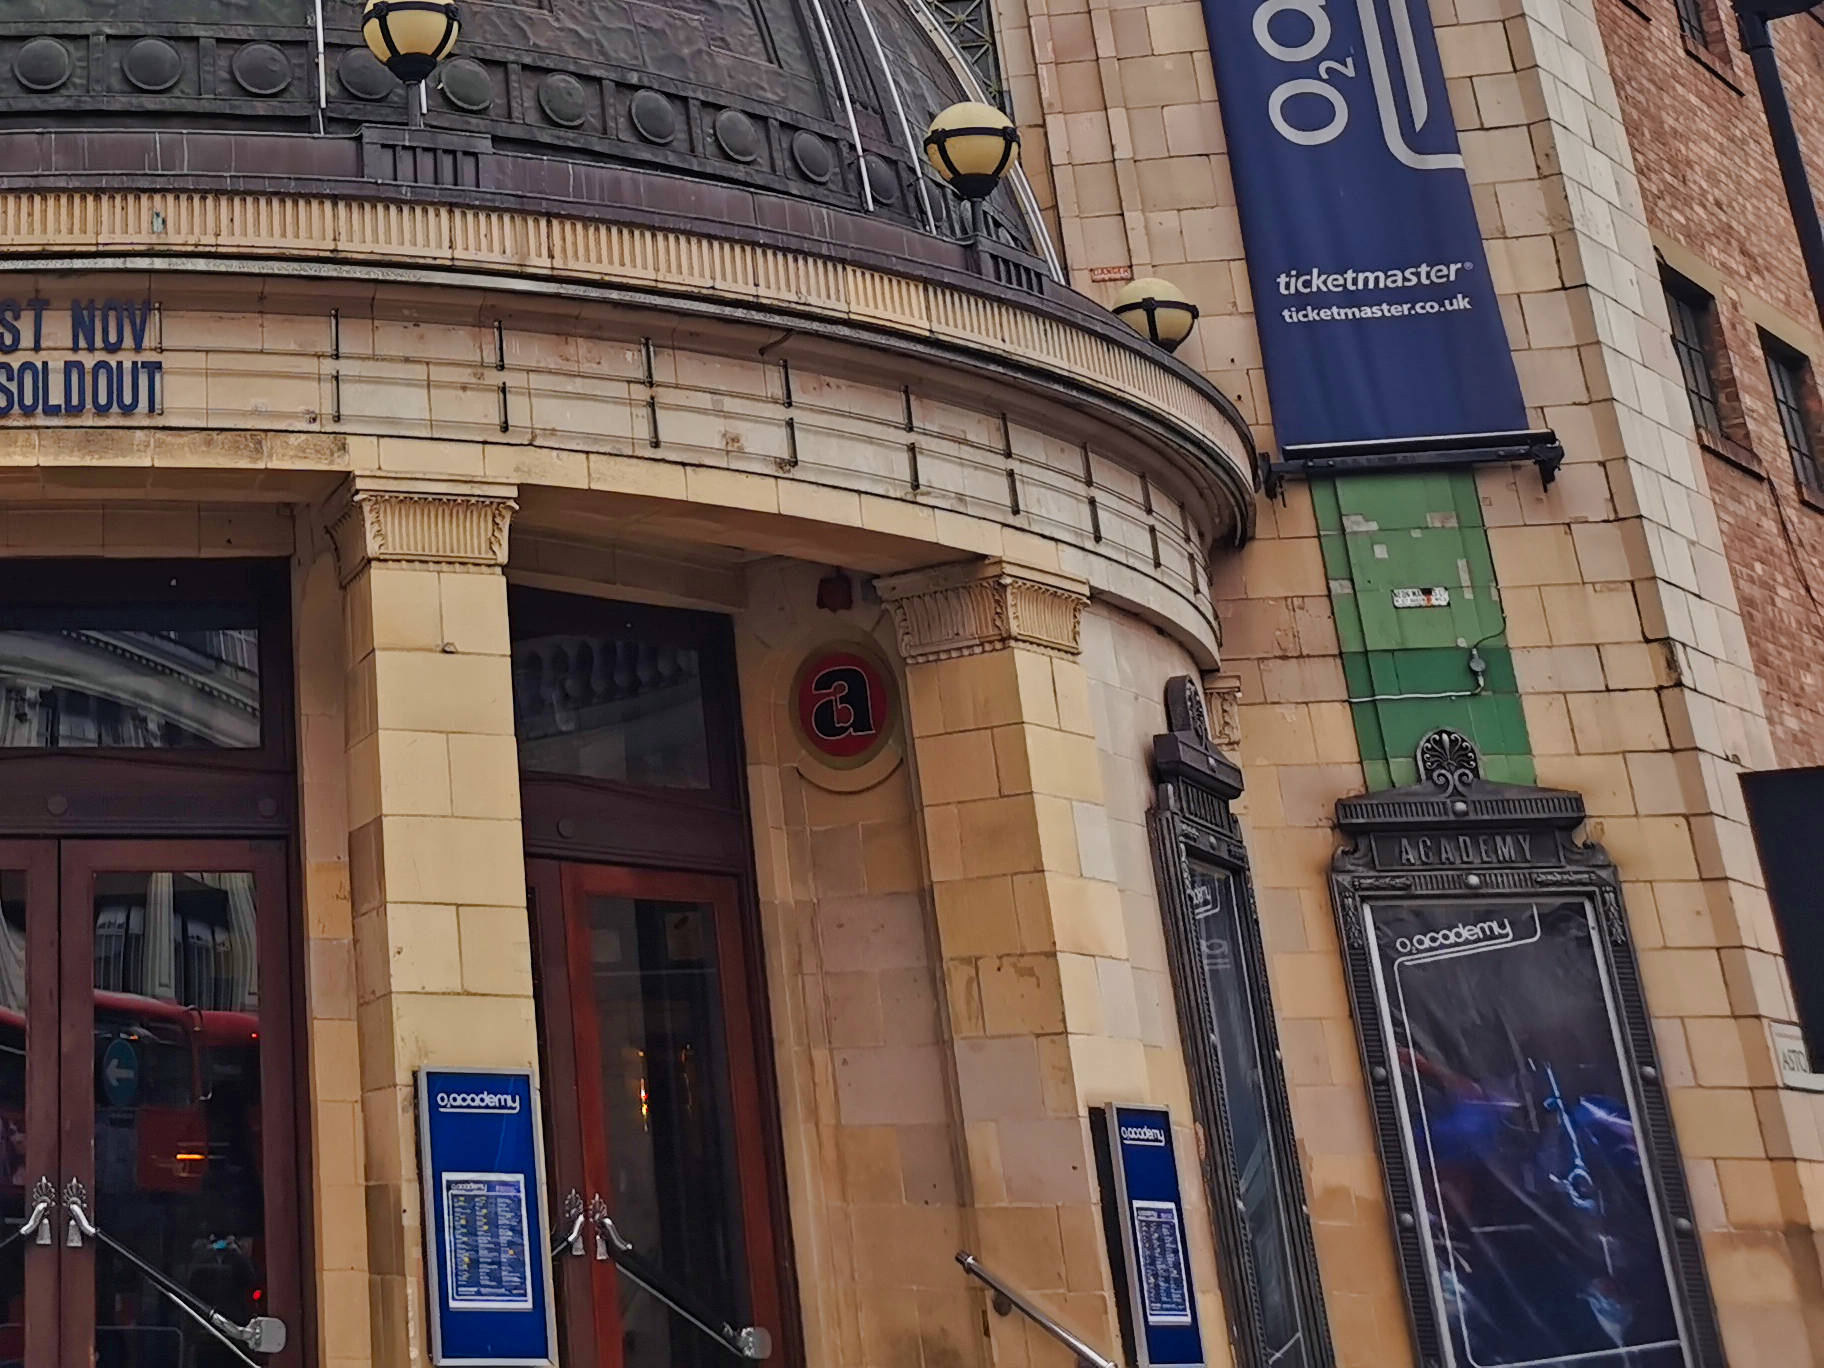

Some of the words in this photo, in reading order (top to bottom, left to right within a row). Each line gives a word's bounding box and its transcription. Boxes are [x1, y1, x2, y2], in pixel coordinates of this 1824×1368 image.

[1281, 293, 1473, 323] ticketmaster.co.uk
[74, 297, 152, 353] NOV
[1400, 834, 1533, 865] ACADEMY
[1782, 1048, 1810, 1074] ASTO
